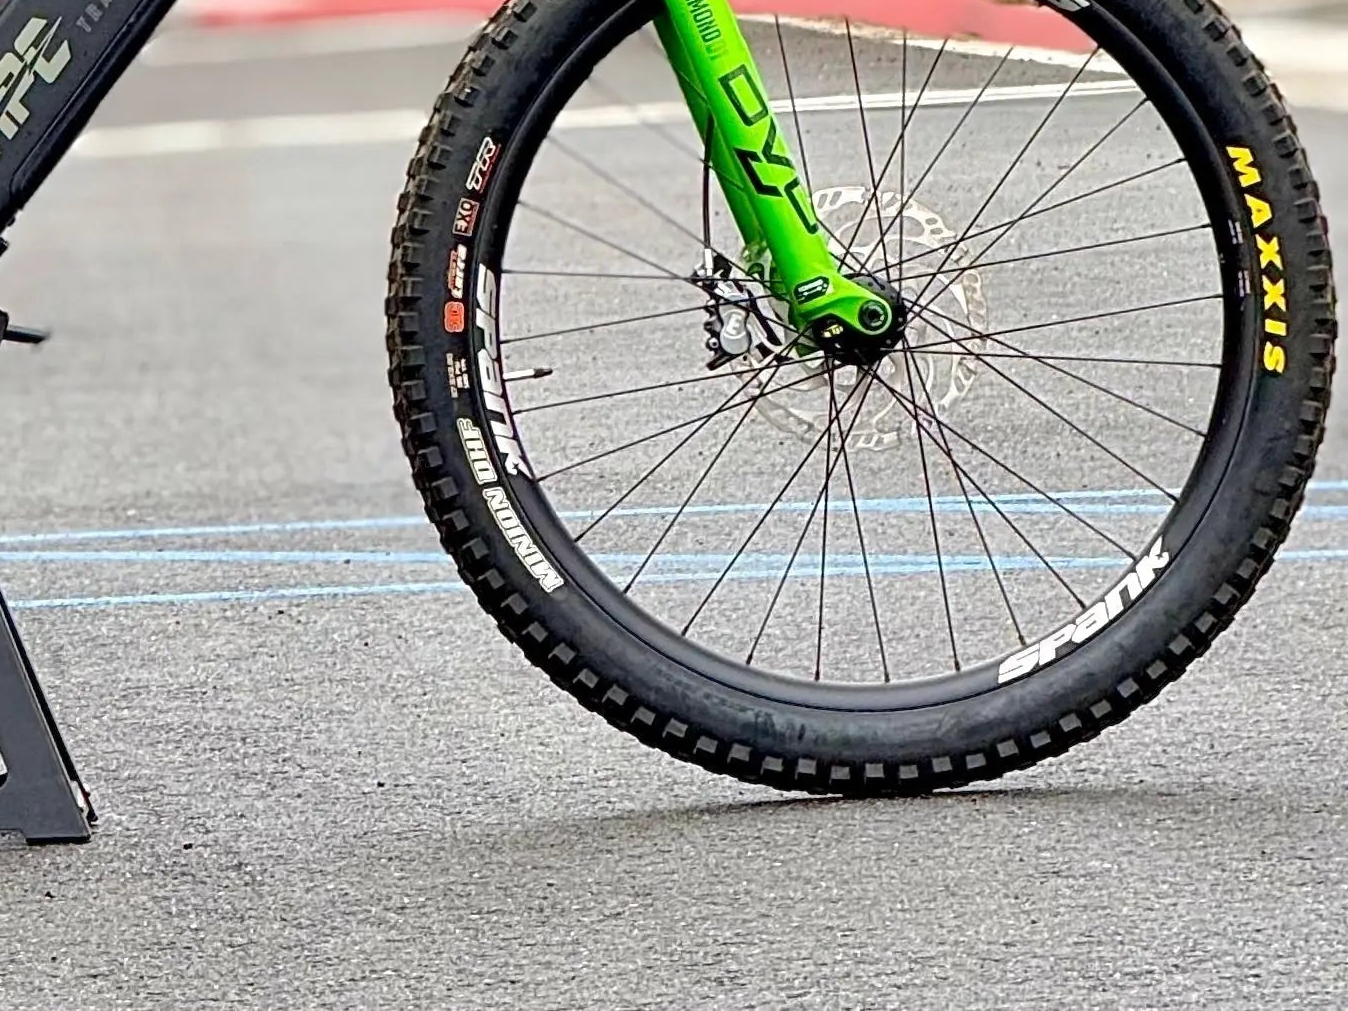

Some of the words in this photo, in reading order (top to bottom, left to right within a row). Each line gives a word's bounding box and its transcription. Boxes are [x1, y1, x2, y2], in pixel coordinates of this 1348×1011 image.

[454, 199, 475, 235] EXO
[1224, 145, 1288, 374] MAXXIS
[456, 416, 498, 485] DHF
[482, 486, 565, 594] MINION
